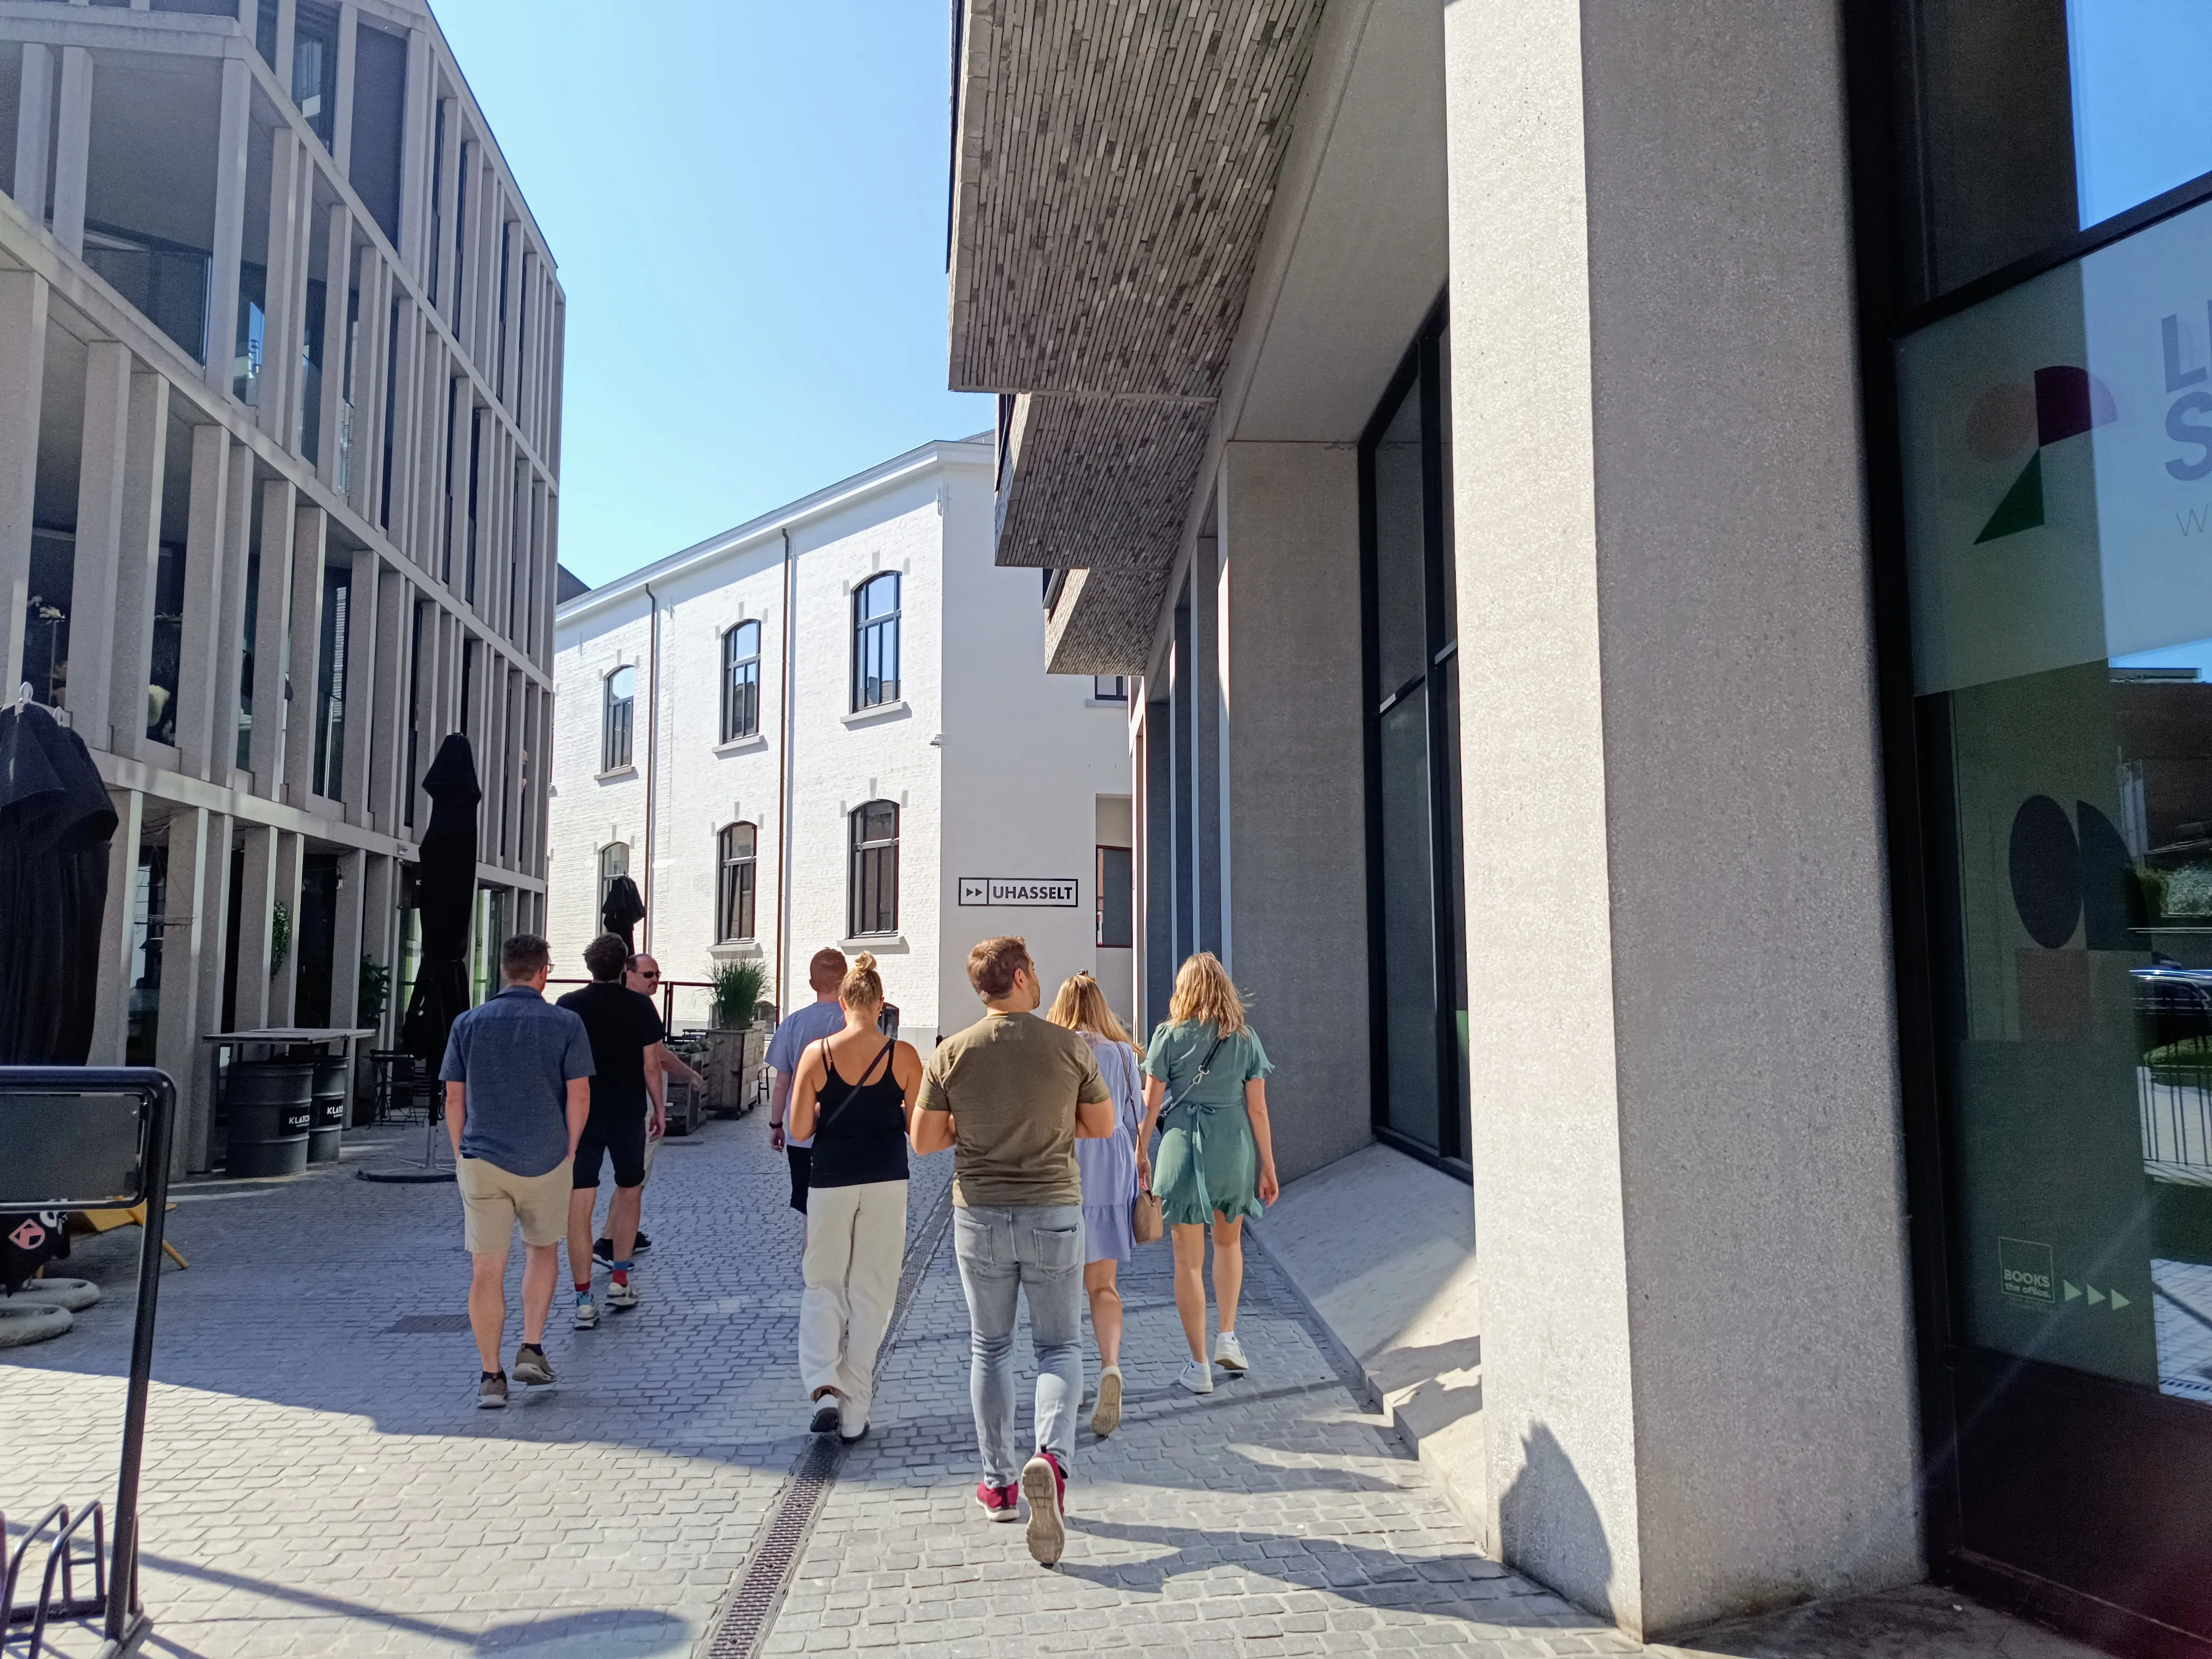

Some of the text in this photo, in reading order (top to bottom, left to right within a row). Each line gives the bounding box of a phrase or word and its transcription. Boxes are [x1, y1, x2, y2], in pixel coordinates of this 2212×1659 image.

[993, 886, 1073, 900] UHASSELT
[2004, 1269, 2050, 1287] BOOKS
[2005, 1282, 2020, 1292] the
